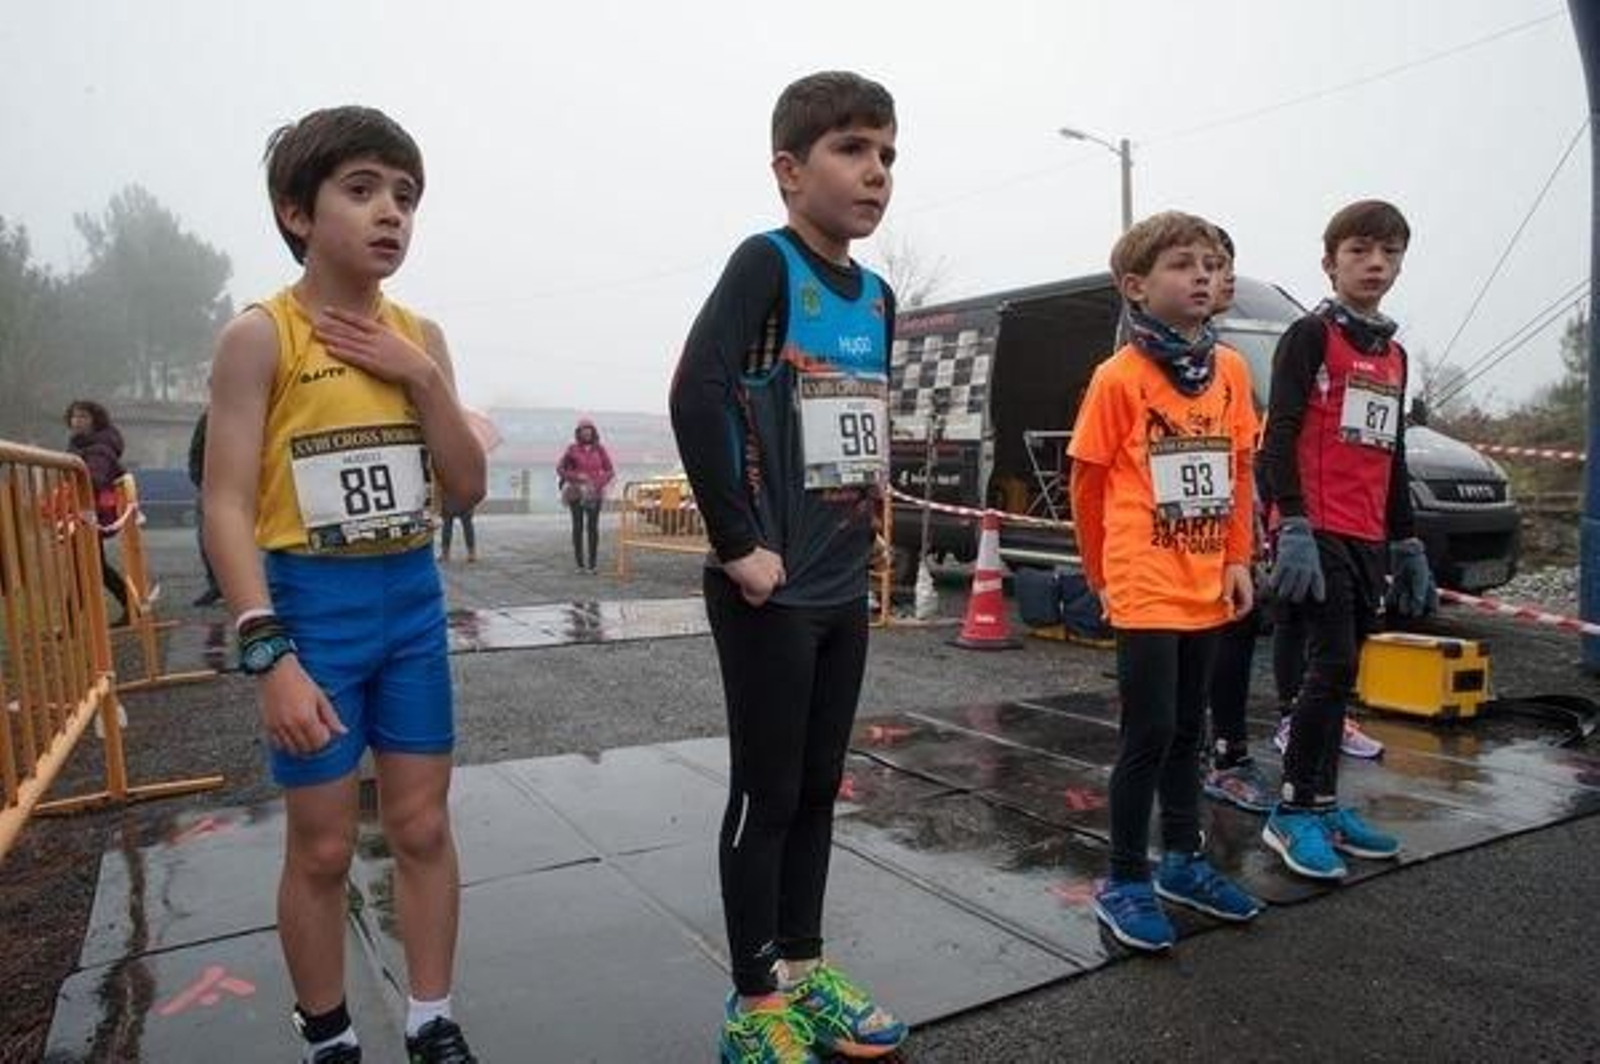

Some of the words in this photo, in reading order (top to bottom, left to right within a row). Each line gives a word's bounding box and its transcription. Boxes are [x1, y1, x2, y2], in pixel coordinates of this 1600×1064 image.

[1366, 401, 1389, 430] 87
[333, 431, 380, 449] CROSS
[840, 412, 878, 456] 98
[340, 464, 396, 517] 89
[1181, 463, 1214, 497] 93
